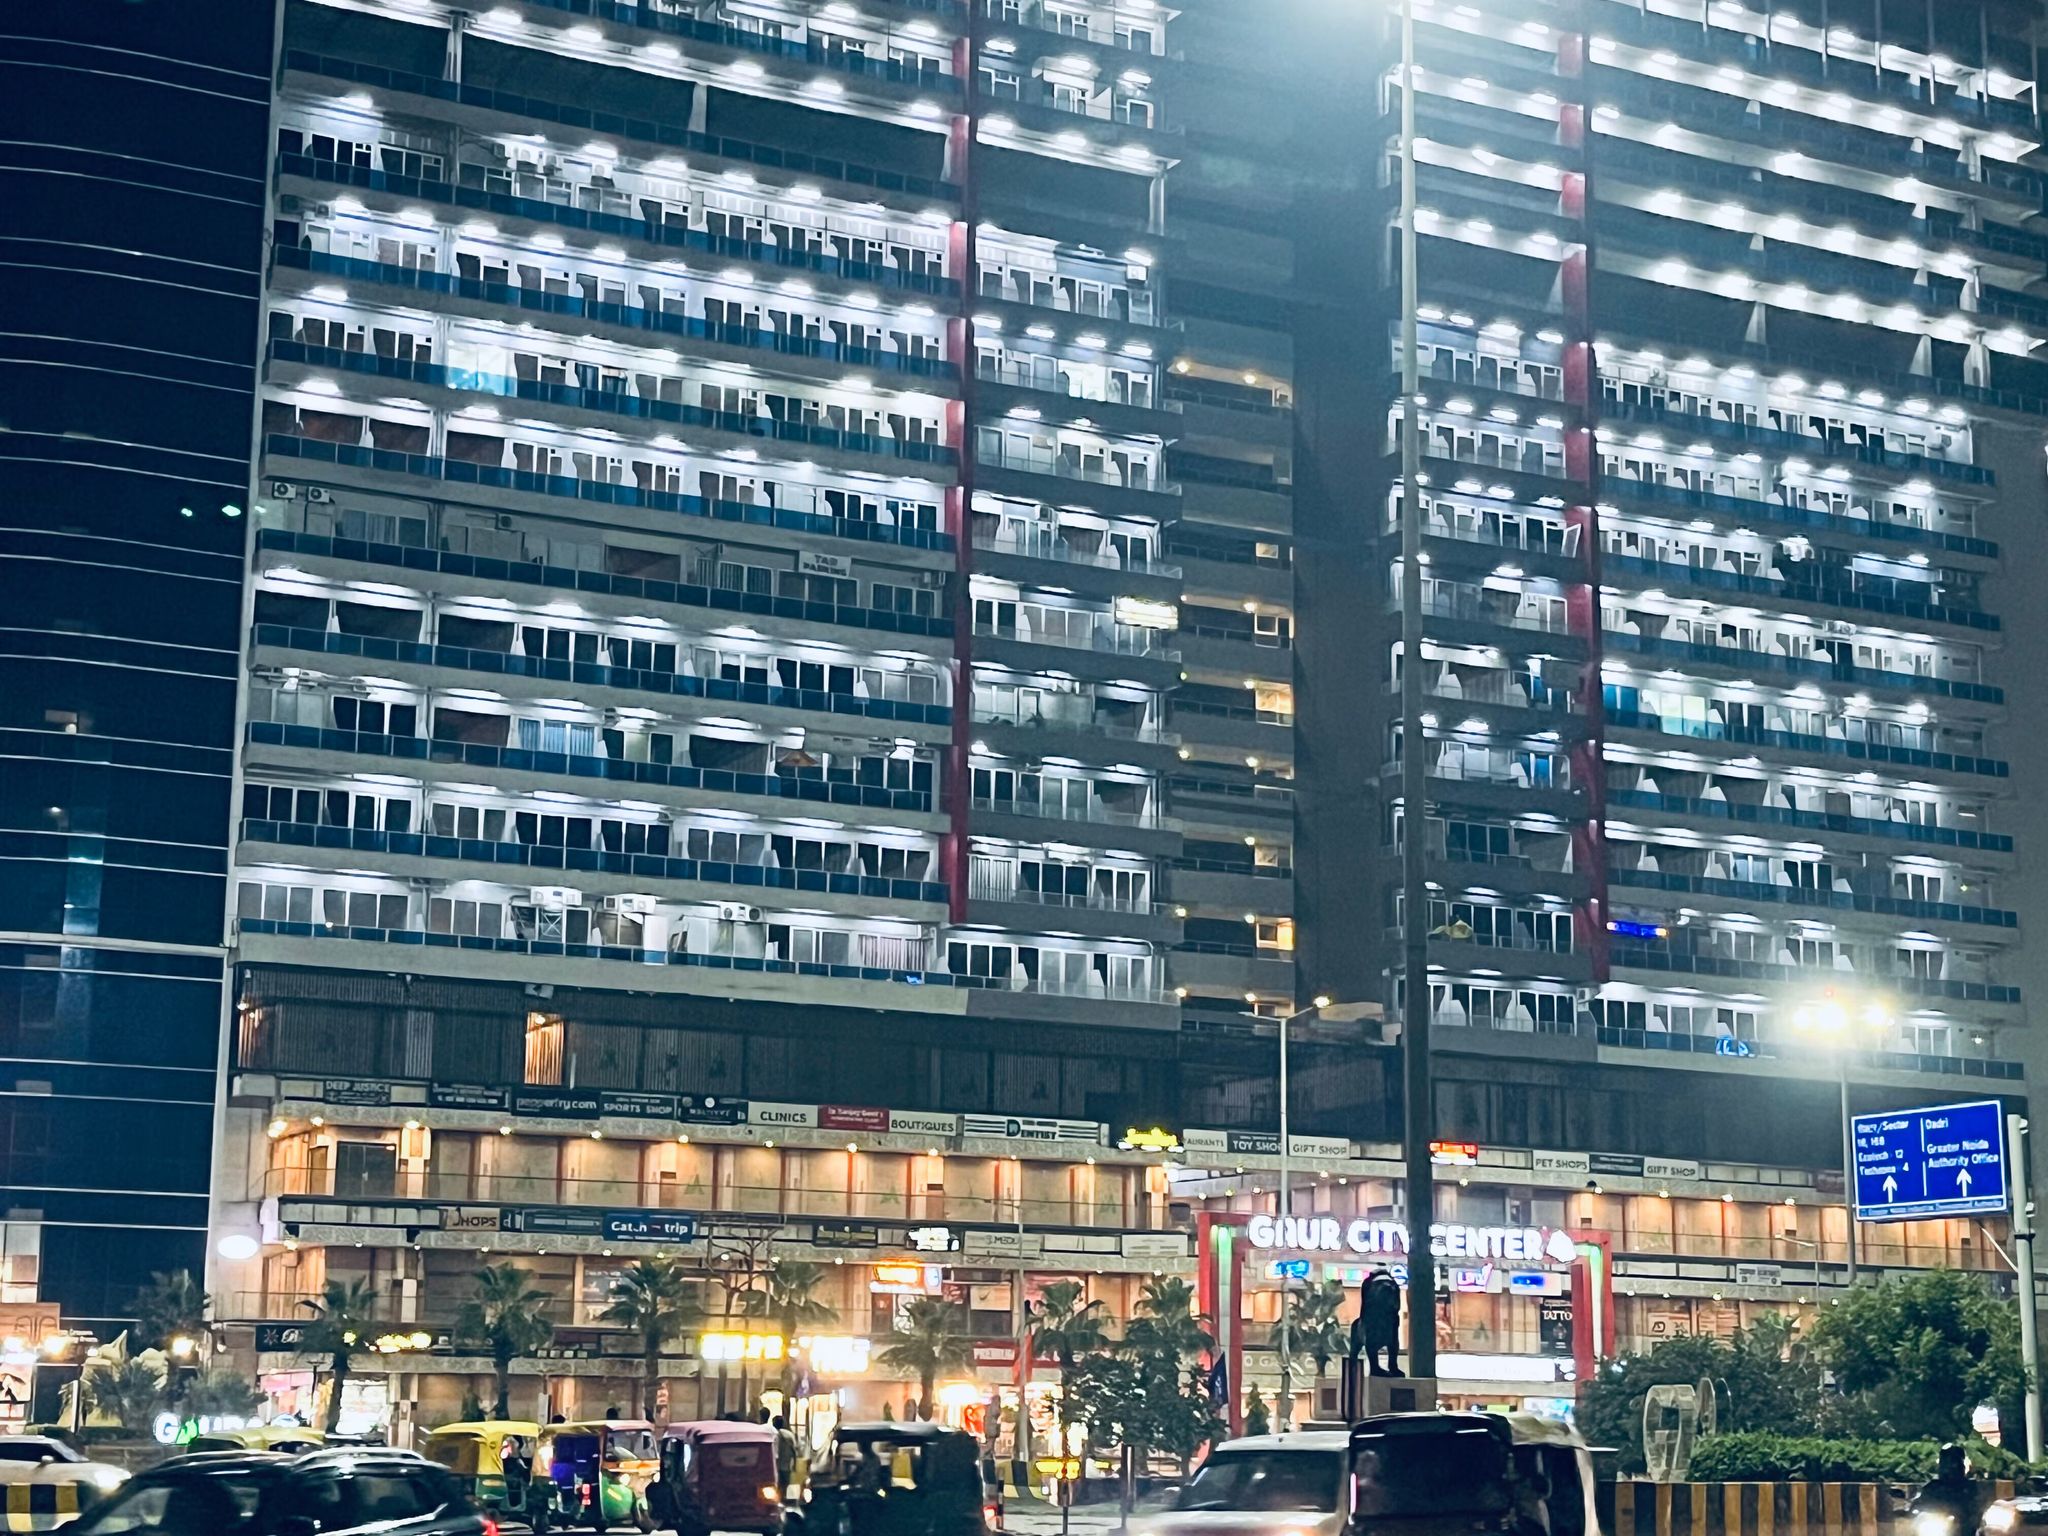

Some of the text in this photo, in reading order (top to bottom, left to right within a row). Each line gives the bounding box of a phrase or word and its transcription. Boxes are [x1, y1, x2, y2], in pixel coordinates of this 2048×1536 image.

[603, 1102, 673, 1115] SPORTS SHOP
[759, 1110, 807, 1124] CLINICS
[891, 1118, 954, 1132] BOUTIQUES
[1232, 1140, 1253, 1150] TOY
[1292, 1142, 1348, 1156] GIFT SHOP
[1535, 1158, 1553, 1168] PET
[1646, 1165, 1668, 1175] GIFT
[1670, 1166, 1696, 1177] SHOP
[664, 1221, 689, 1236] trip
[1248, 1215, 1341, 1251] GAUR
